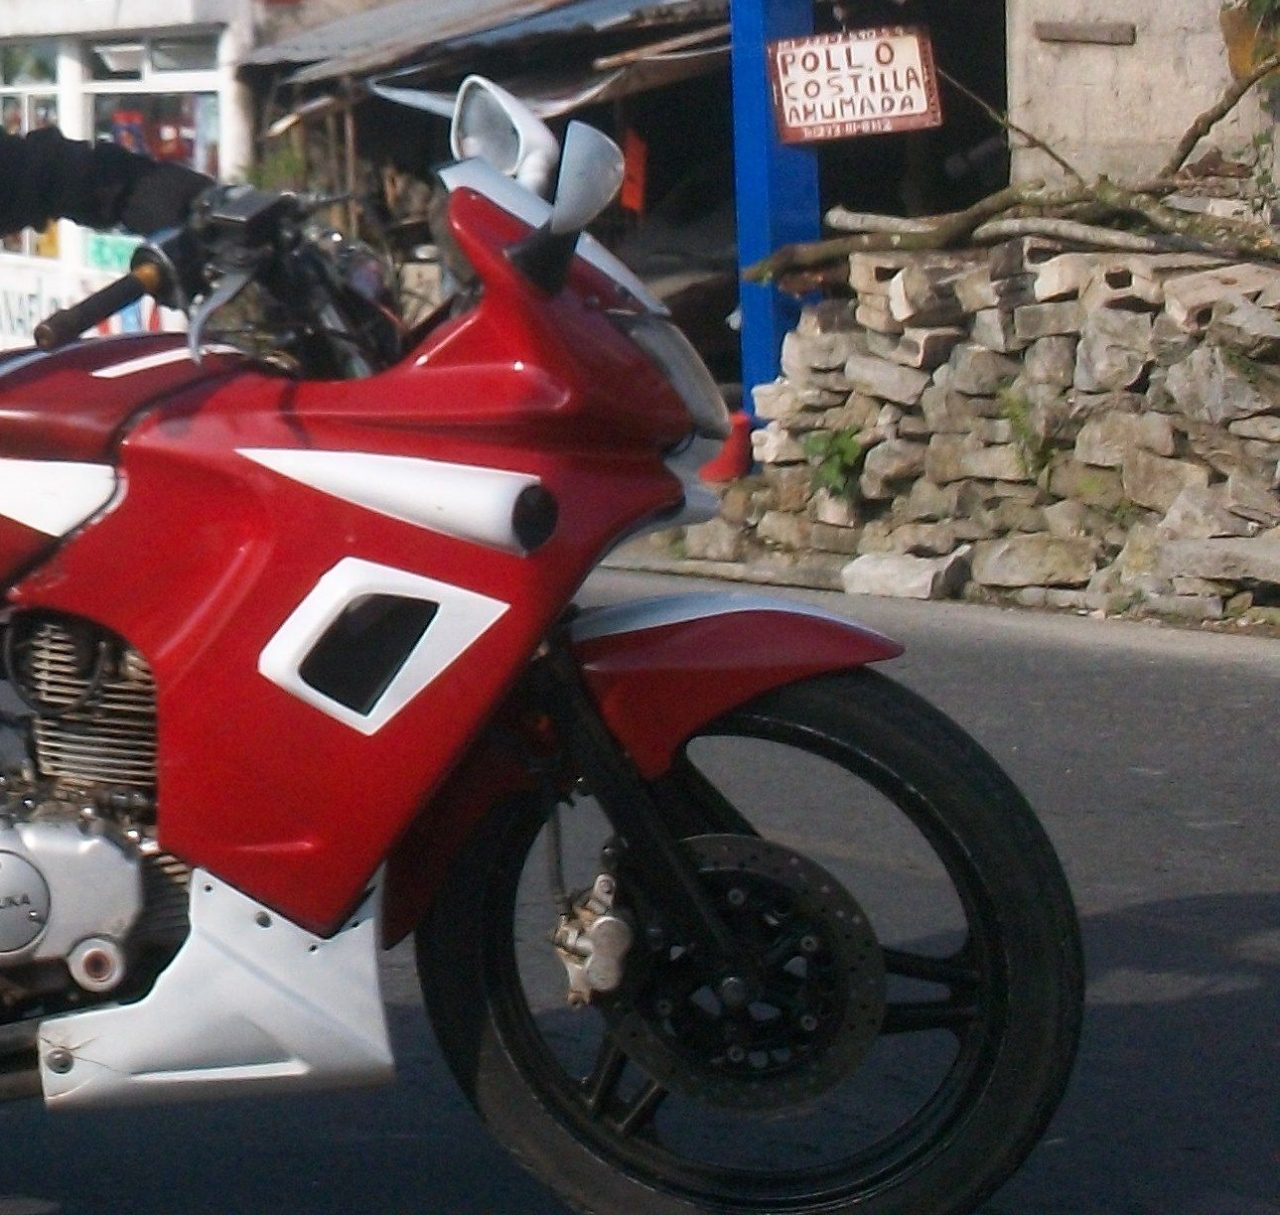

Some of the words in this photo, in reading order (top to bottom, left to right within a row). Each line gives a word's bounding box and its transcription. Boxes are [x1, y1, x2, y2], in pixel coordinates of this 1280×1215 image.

[780, 41, 896, 77] POLLO
[784, 66, 921, 101] COSTILLA
[788, 95, 915, 124] AHUMADA
